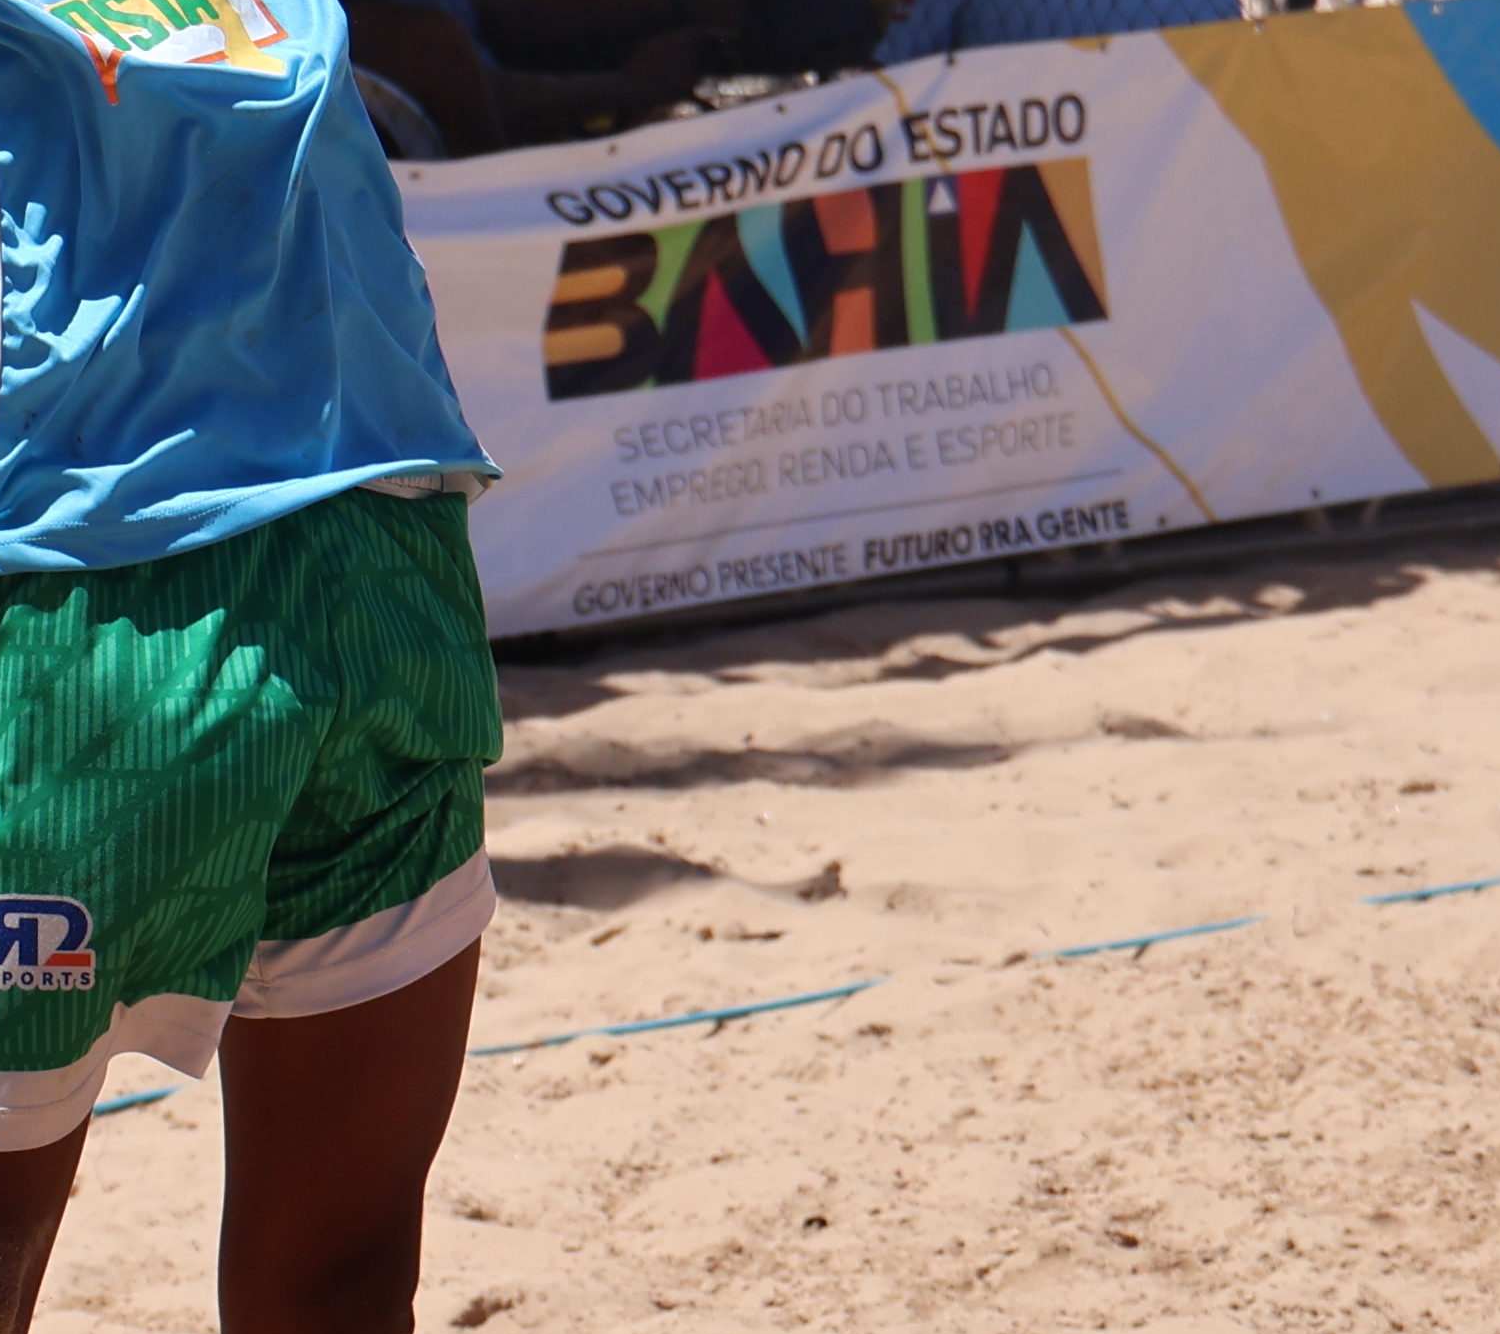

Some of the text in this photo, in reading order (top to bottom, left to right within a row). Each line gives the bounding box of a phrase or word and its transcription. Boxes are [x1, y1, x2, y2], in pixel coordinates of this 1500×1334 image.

[547, 94, 1087, 227] GOVERNO DO ESTADO
[544, 165, 1110, 402] BAHIA
[614, 399, 808, 465] SECRETARIA
[821, 387, 867, 429] DO
[778, 440, 900, 487] RENDA
[905, 434, 930, 469] E
[937, 411, 1076, 465] ESPORTE
[572, 499, 1130, 615] GOVERNO PRESENTE FUTURO PRA GENTE
